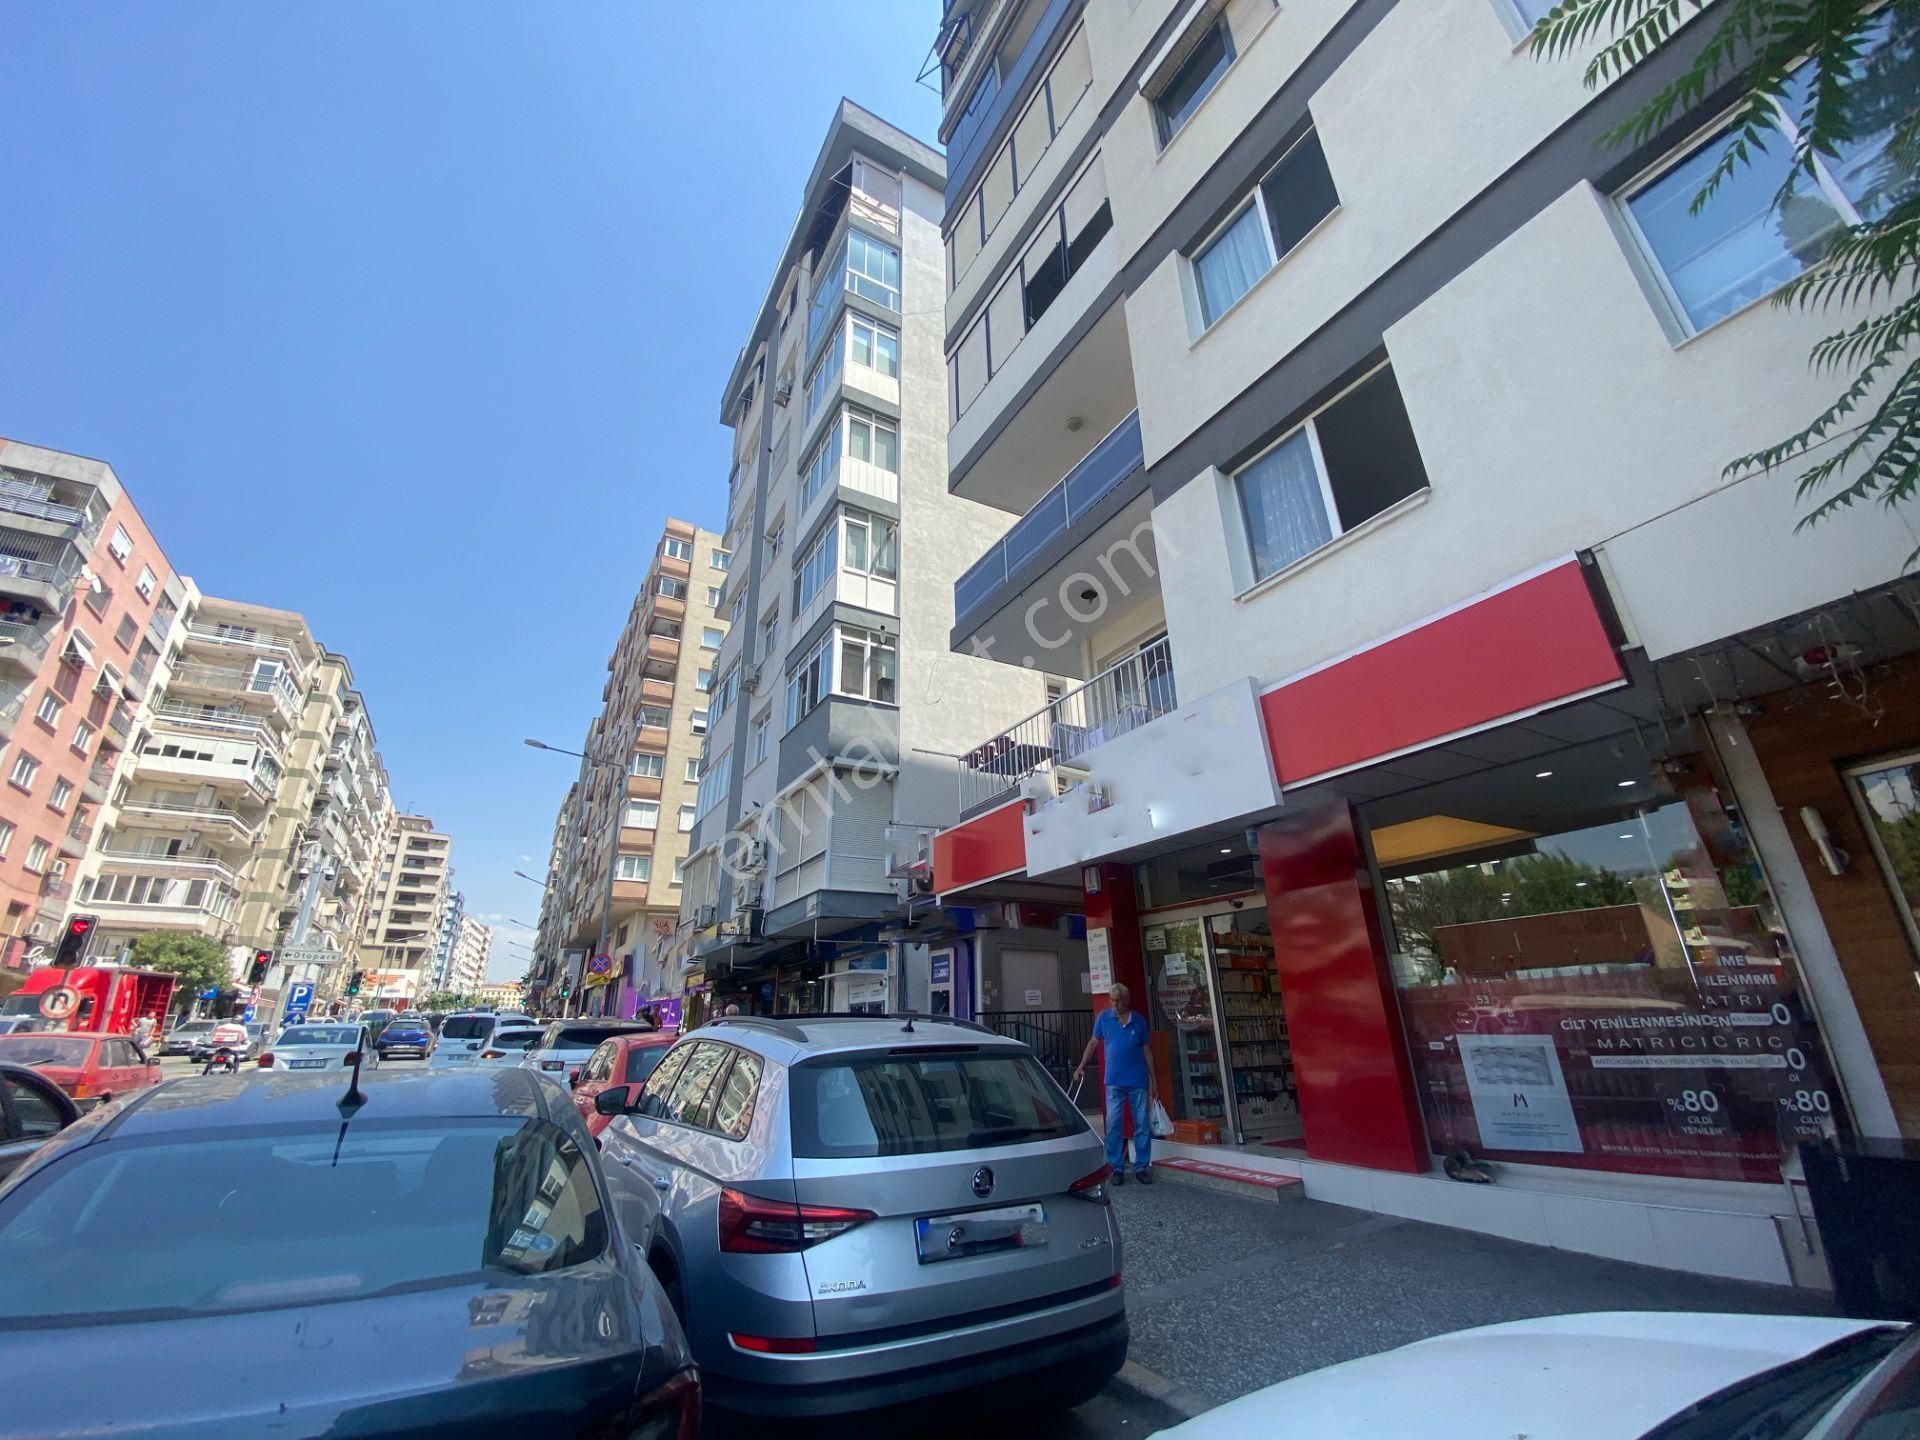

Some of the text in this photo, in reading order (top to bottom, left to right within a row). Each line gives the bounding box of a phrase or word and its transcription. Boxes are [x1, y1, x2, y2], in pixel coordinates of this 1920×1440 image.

[294, 951, 337, 961] Otopark
[292, 986, 308, 1002] P
[1666, 1089, 1719, 1113] %80
[1779, 1089, 1831, 1113] %80
